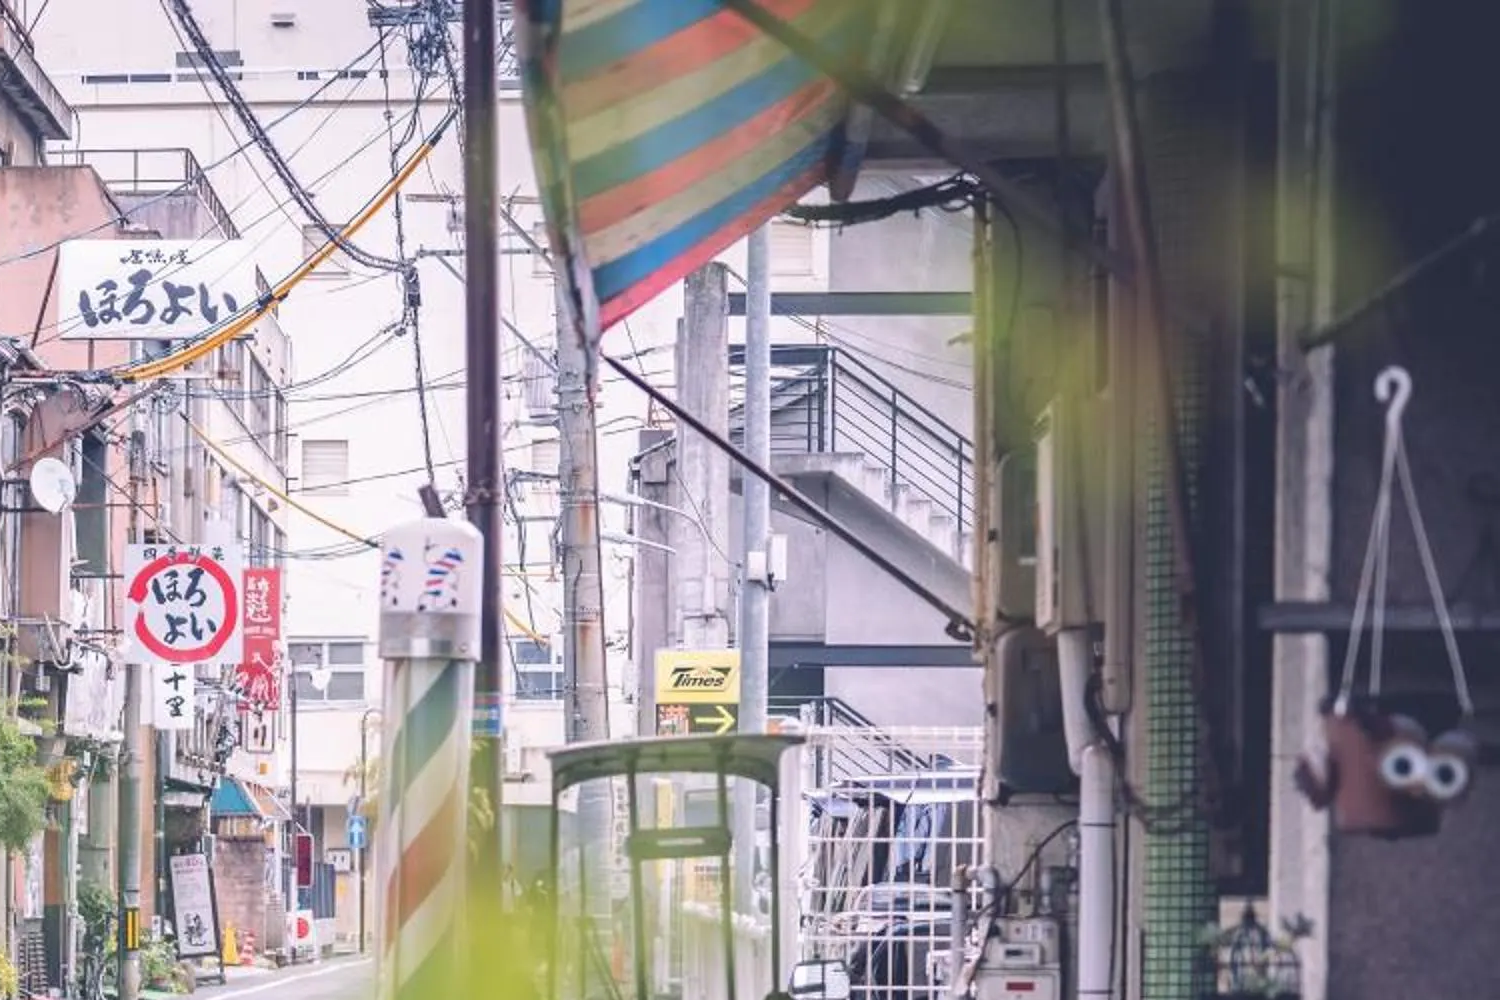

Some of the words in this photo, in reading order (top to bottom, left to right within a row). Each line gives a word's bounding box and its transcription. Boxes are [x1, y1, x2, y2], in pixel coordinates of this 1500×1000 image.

[79, 268, 238, 328] ほろよい
[152, 567, 206, 606] ほろ
[164, 612, 218, 645] よい
[671, 667, 731, 689] Times
